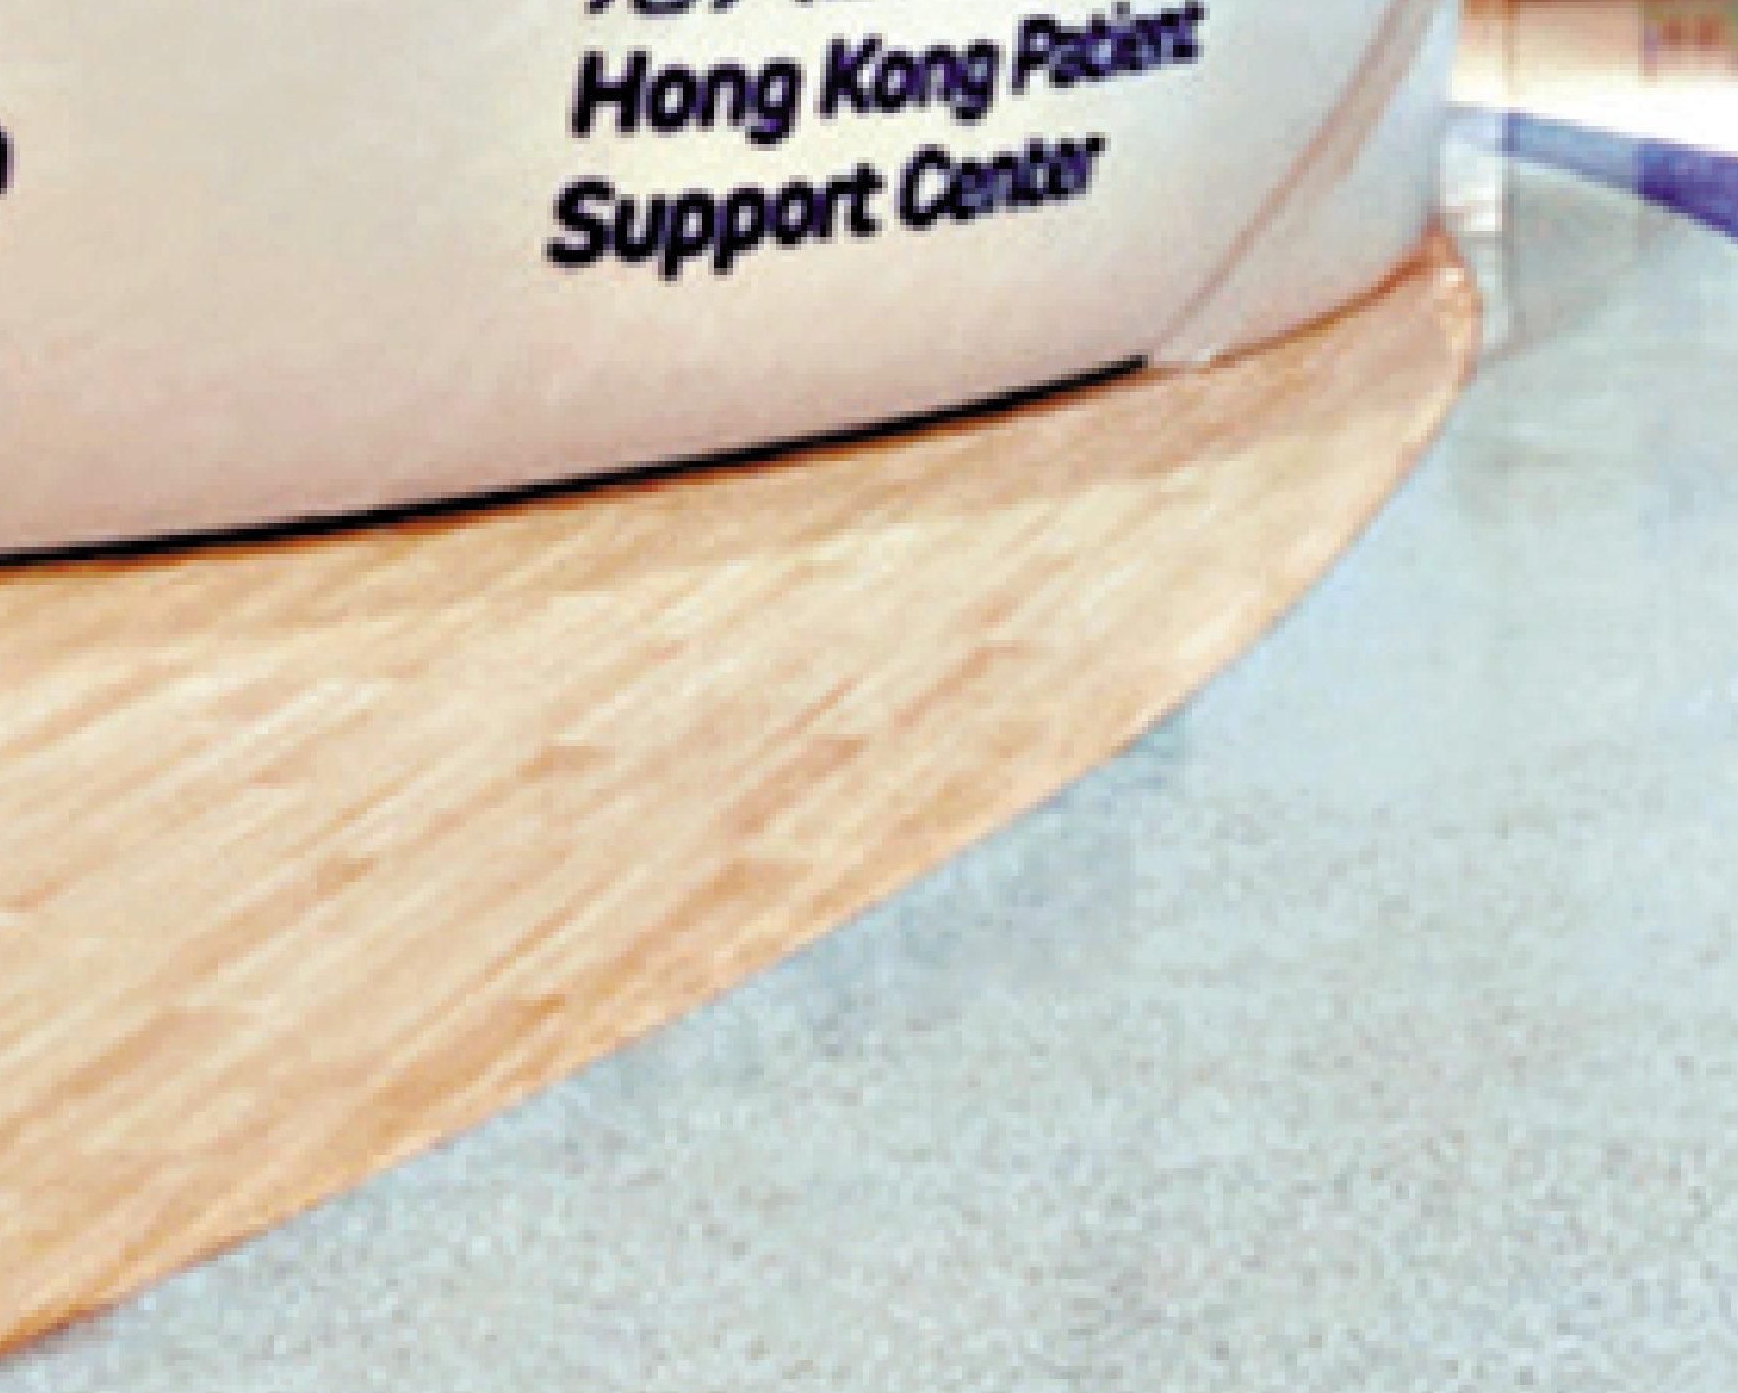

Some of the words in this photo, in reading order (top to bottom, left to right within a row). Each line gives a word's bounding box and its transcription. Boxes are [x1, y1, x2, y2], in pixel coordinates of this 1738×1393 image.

[570, 48, 802, 146] Hong
[816, 33, 1001, 123] Kong
[546, 161, 884, 281] Support
[898, 133, 1106, 231] Center
